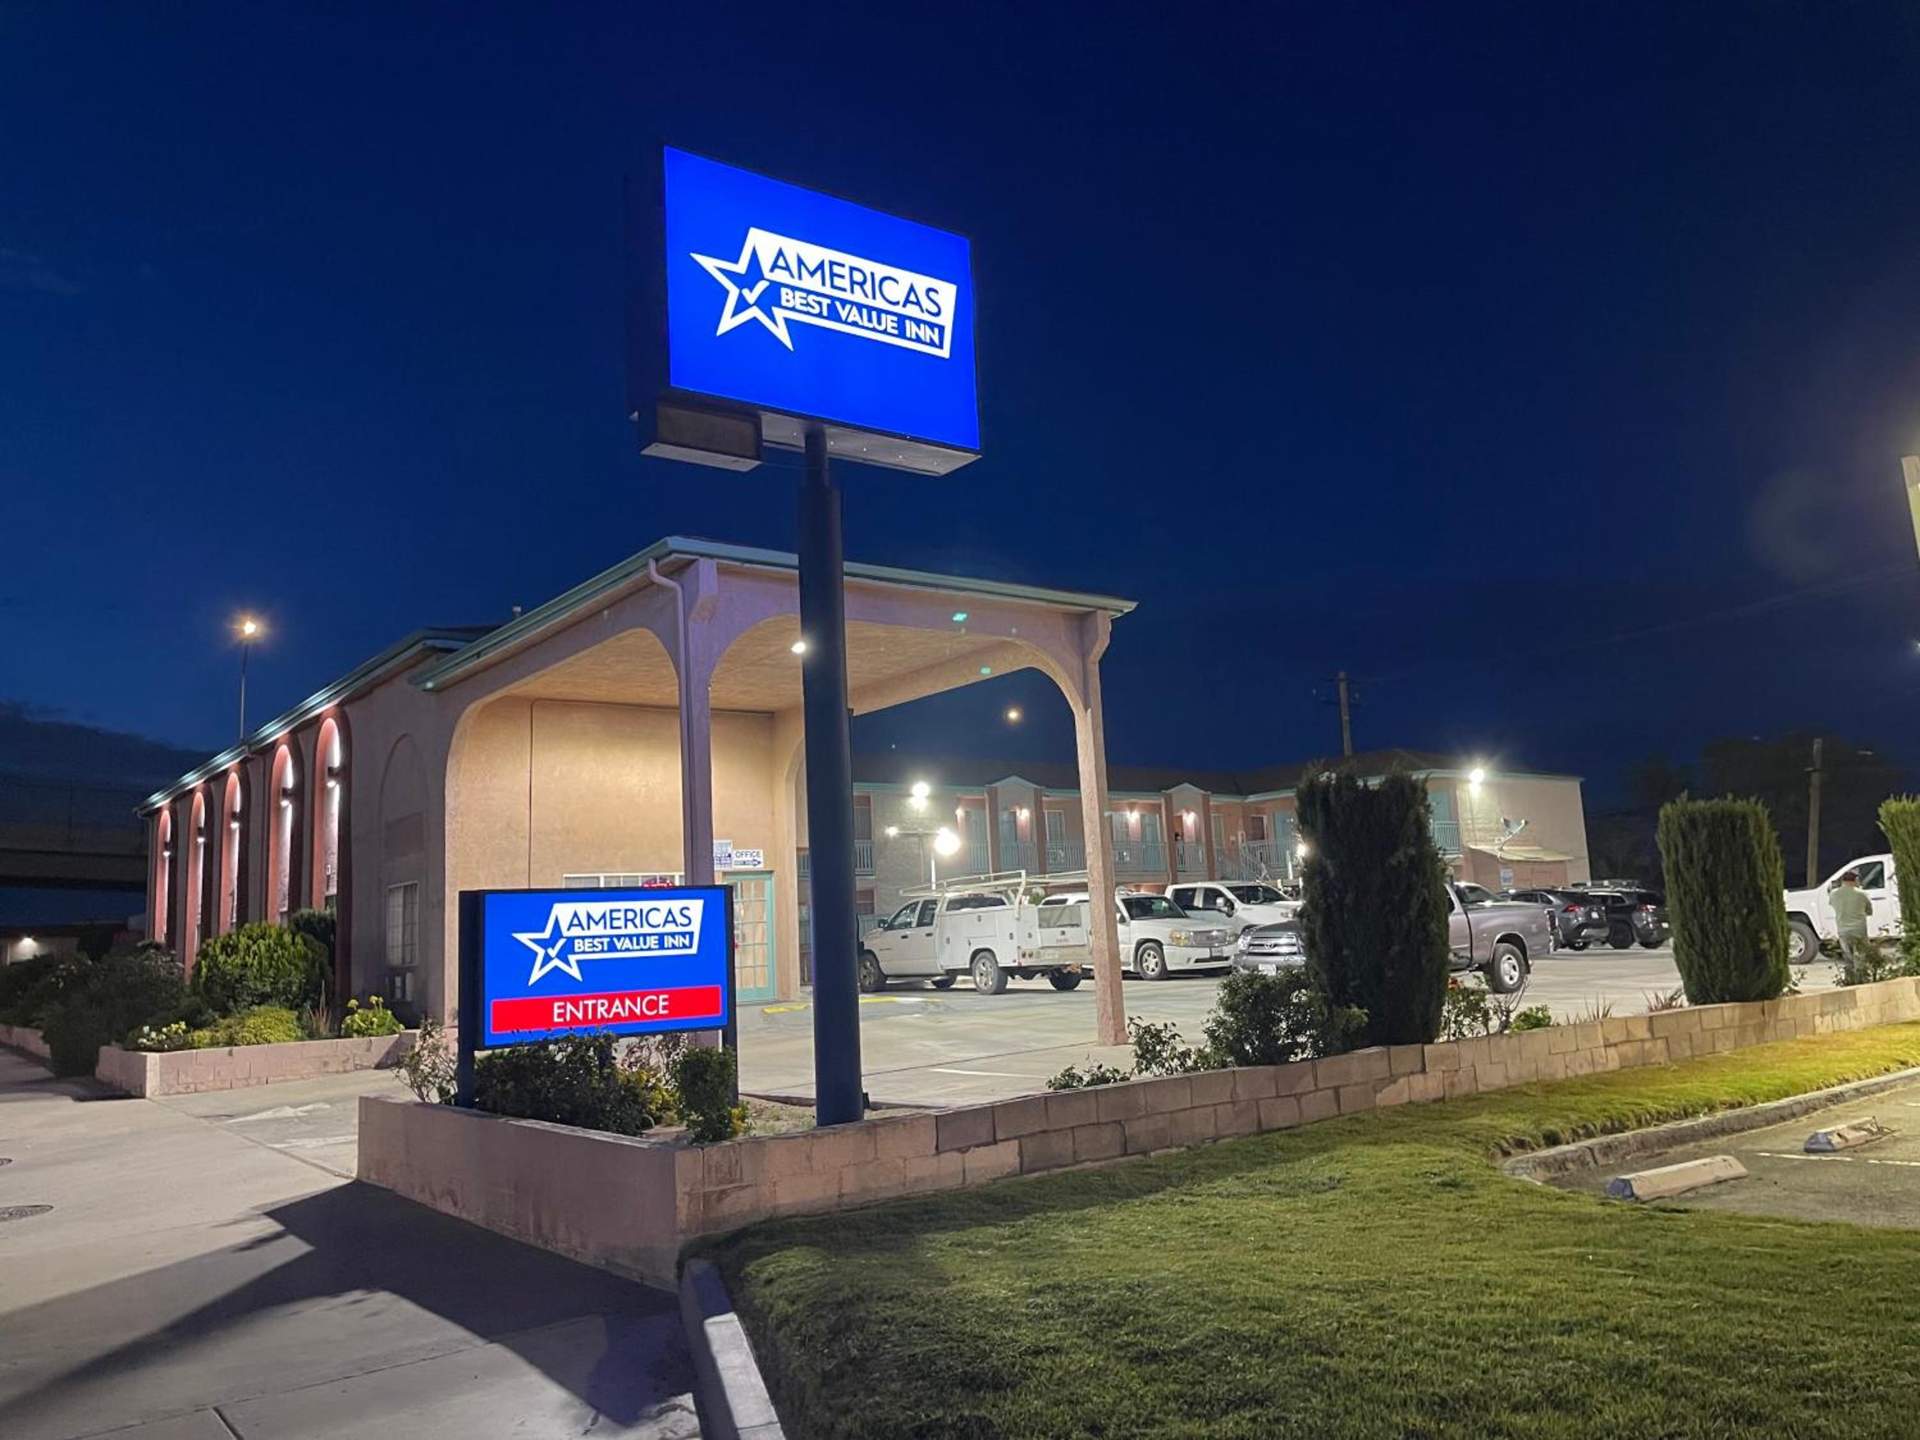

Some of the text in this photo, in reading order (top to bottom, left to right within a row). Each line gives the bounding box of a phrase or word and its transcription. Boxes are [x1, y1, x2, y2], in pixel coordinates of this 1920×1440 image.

[769, 246, 942, 317] AMERICAS
[780, 287, 940, 346] BEST VALUE INN
[735, 850, 761, 858] OFFICE
[566, 906, 692, 931] AMERICAS
[574, 934, 690, 953] BEST VALUE INN
[552, 994, 669, 1023] ENTRANCE
